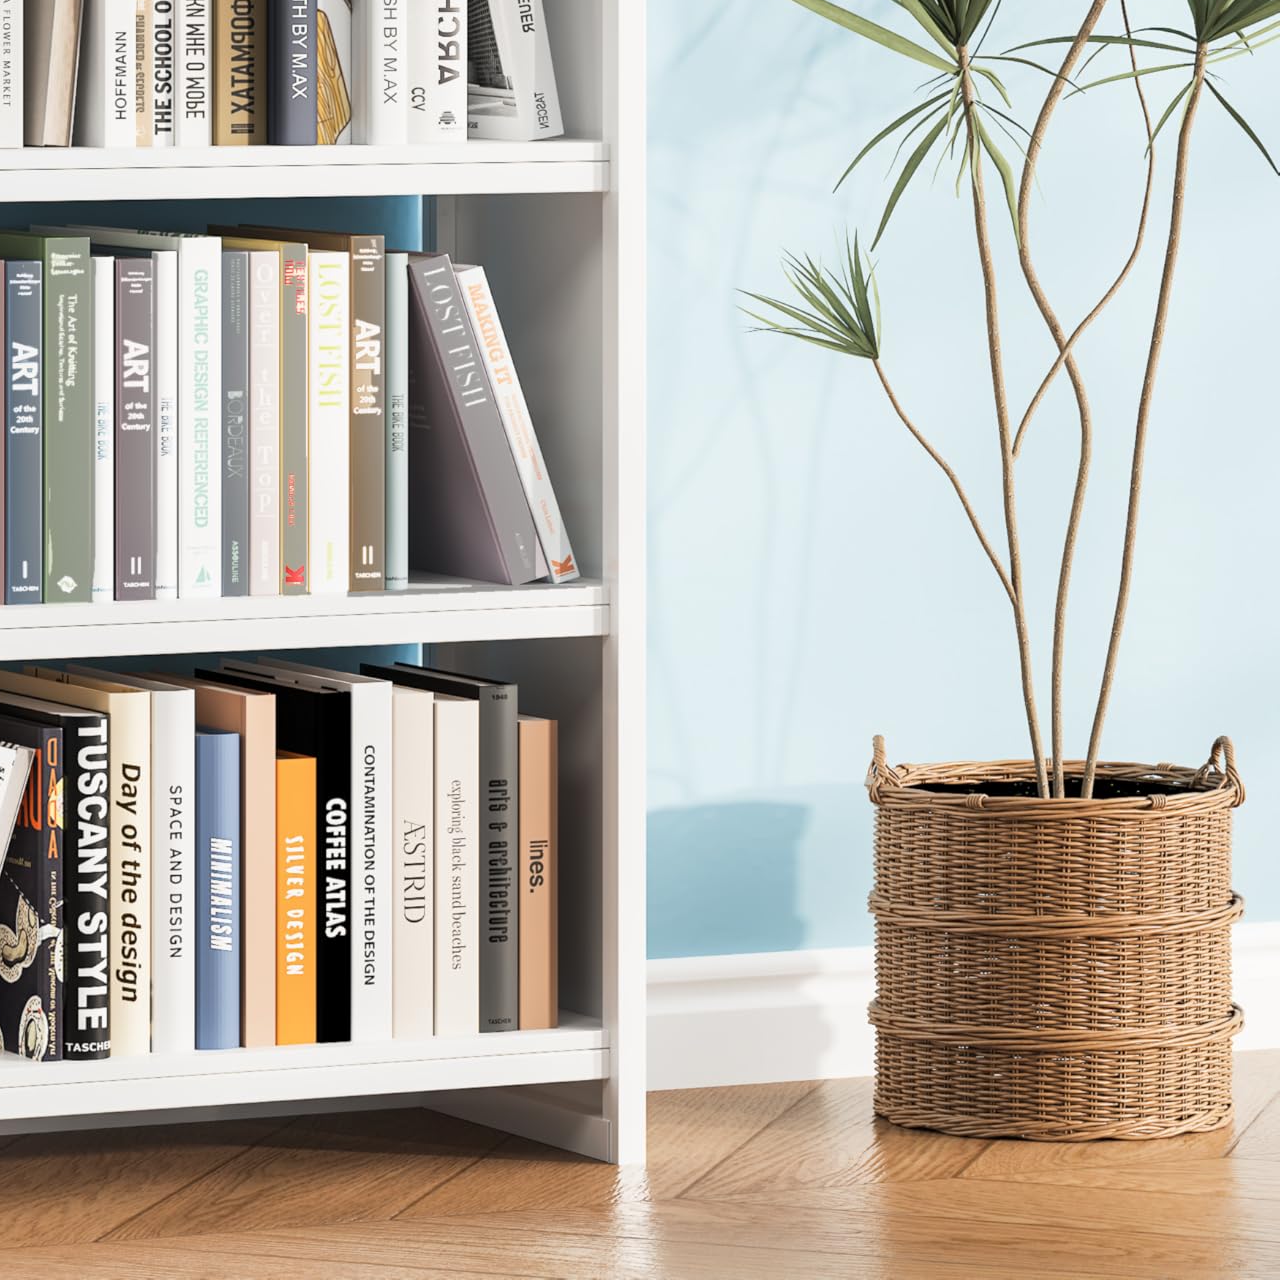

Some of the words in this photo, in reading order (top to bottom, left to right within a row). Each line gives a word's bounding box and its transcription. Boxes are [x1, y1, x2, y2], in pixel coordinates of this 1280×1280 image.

[154, 19, 172, 93] SCHOOL
[292, 24, 308, 47] BY
[383, 27, 397, 51] BY
[114, 31, 127, 120] HOFFMANN
[292, 53, 308, 99] M.AX
[383, 58, 397, 104] M.AX
[154, 99, 172, 135] THE
[194, 269, 208, 343] GRAPHIC
[12, 342, 38, 395] ART
[194, 351, 208, 411] DESIGN
[194, 418, 208, 527] REFERENCED
[77, 718, 108, 900] TUSCANY
[116, 764, 141, 814] Day
[488, 780, 509, 811] arts
[121, 824, 142, 852] of
[285, 836, 304, 899] SILVER
[529, 840, 548, 893] lines.
[121, 859, 142, 903] the
[210, 838, 232, 951] MINIMALISM
[488, 841, 512, 943] architecture
[77, 912, 108, 1030] STYLE
[116, 913, 142, 1002] design
[285, 910, 304, 975] DESIGN
